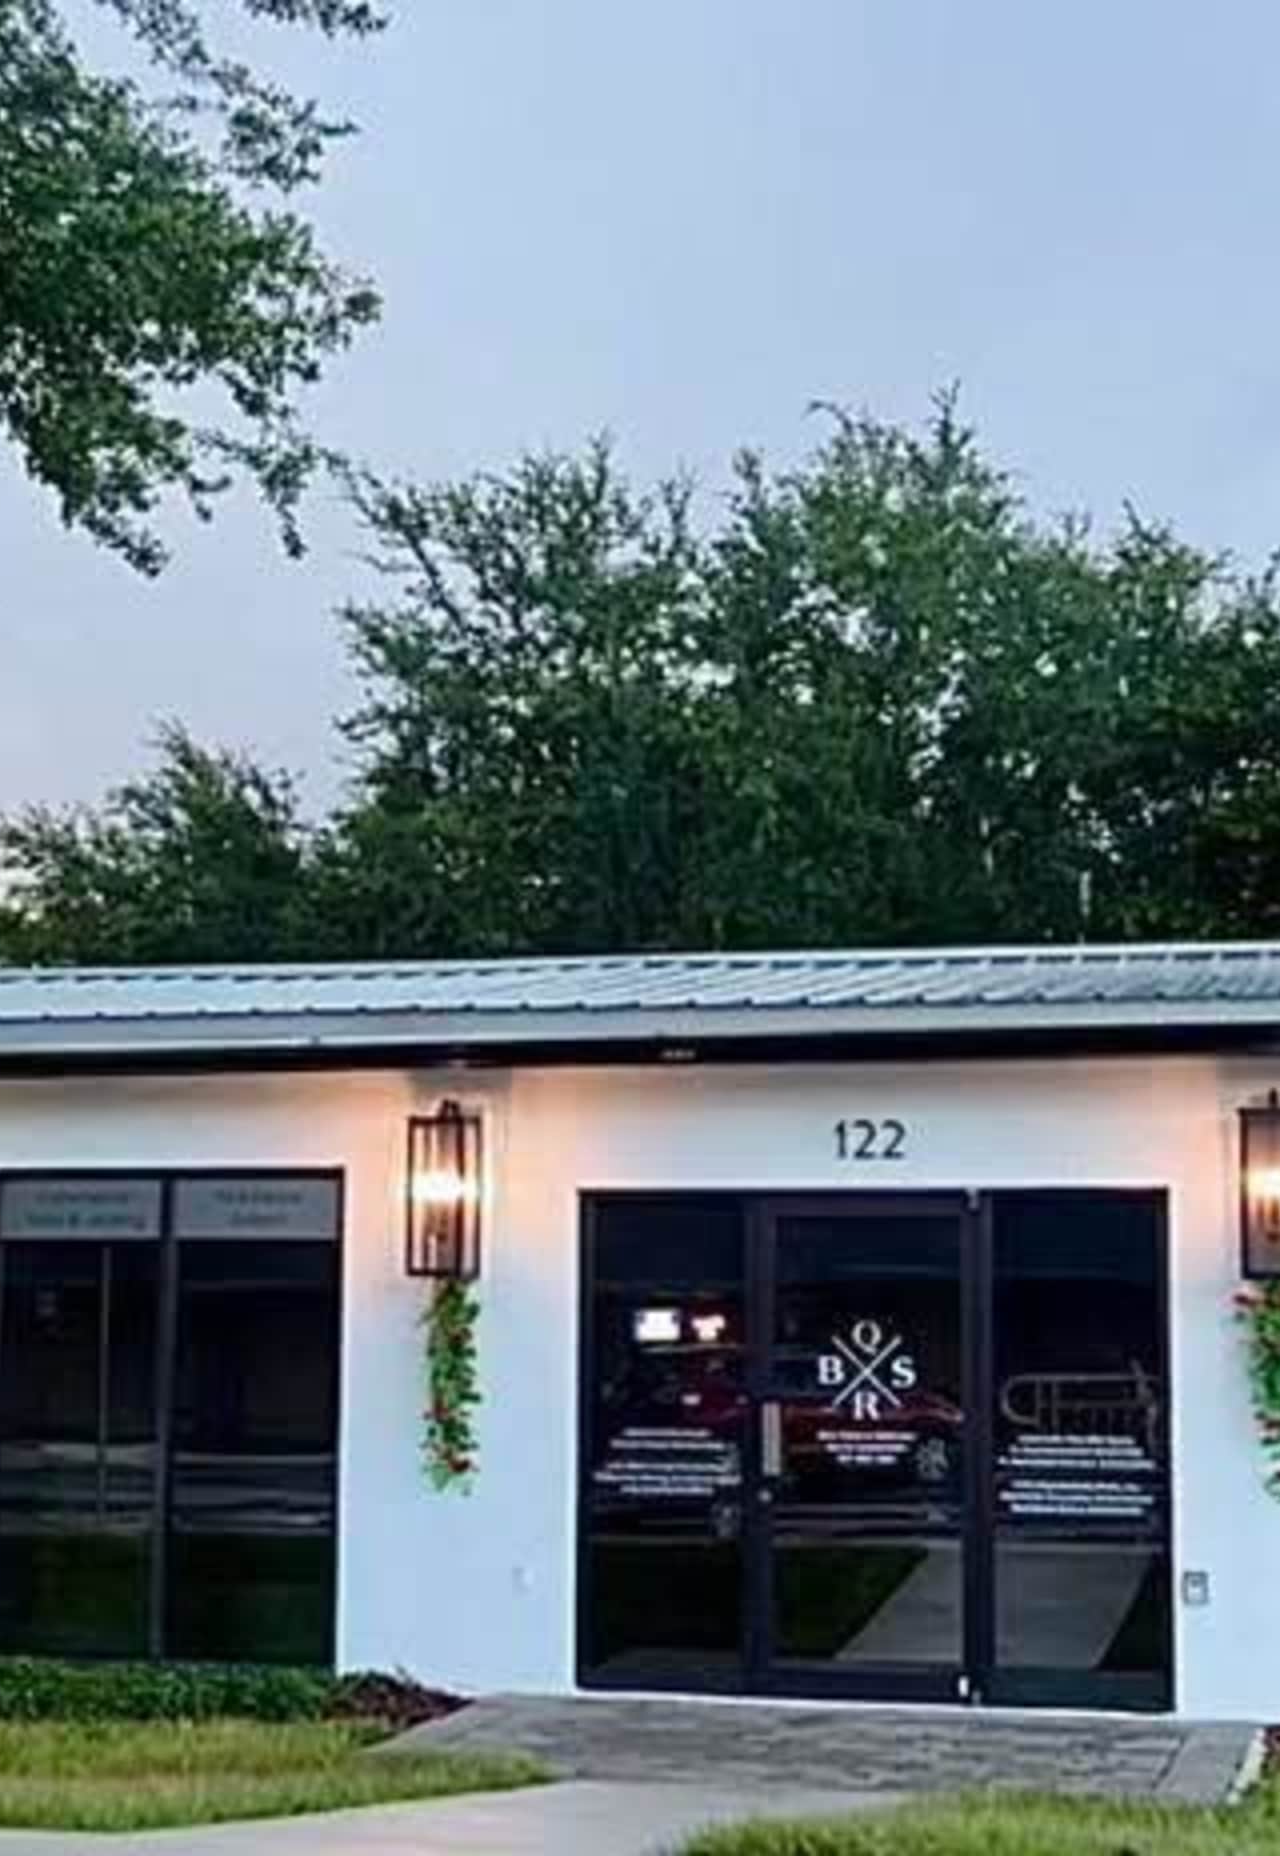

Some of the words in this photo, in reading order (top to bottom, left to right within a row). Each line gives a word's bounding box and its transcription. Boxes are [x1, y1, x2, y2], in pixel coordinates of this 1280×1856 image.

[834, 1118, 905, 1160] 122
[851, 1319, 882, 1356] Q
[818, 1354, 845, 1386] B
[890, 1355, 917, 1390] S
[853, 1390, 880, 1421] R
